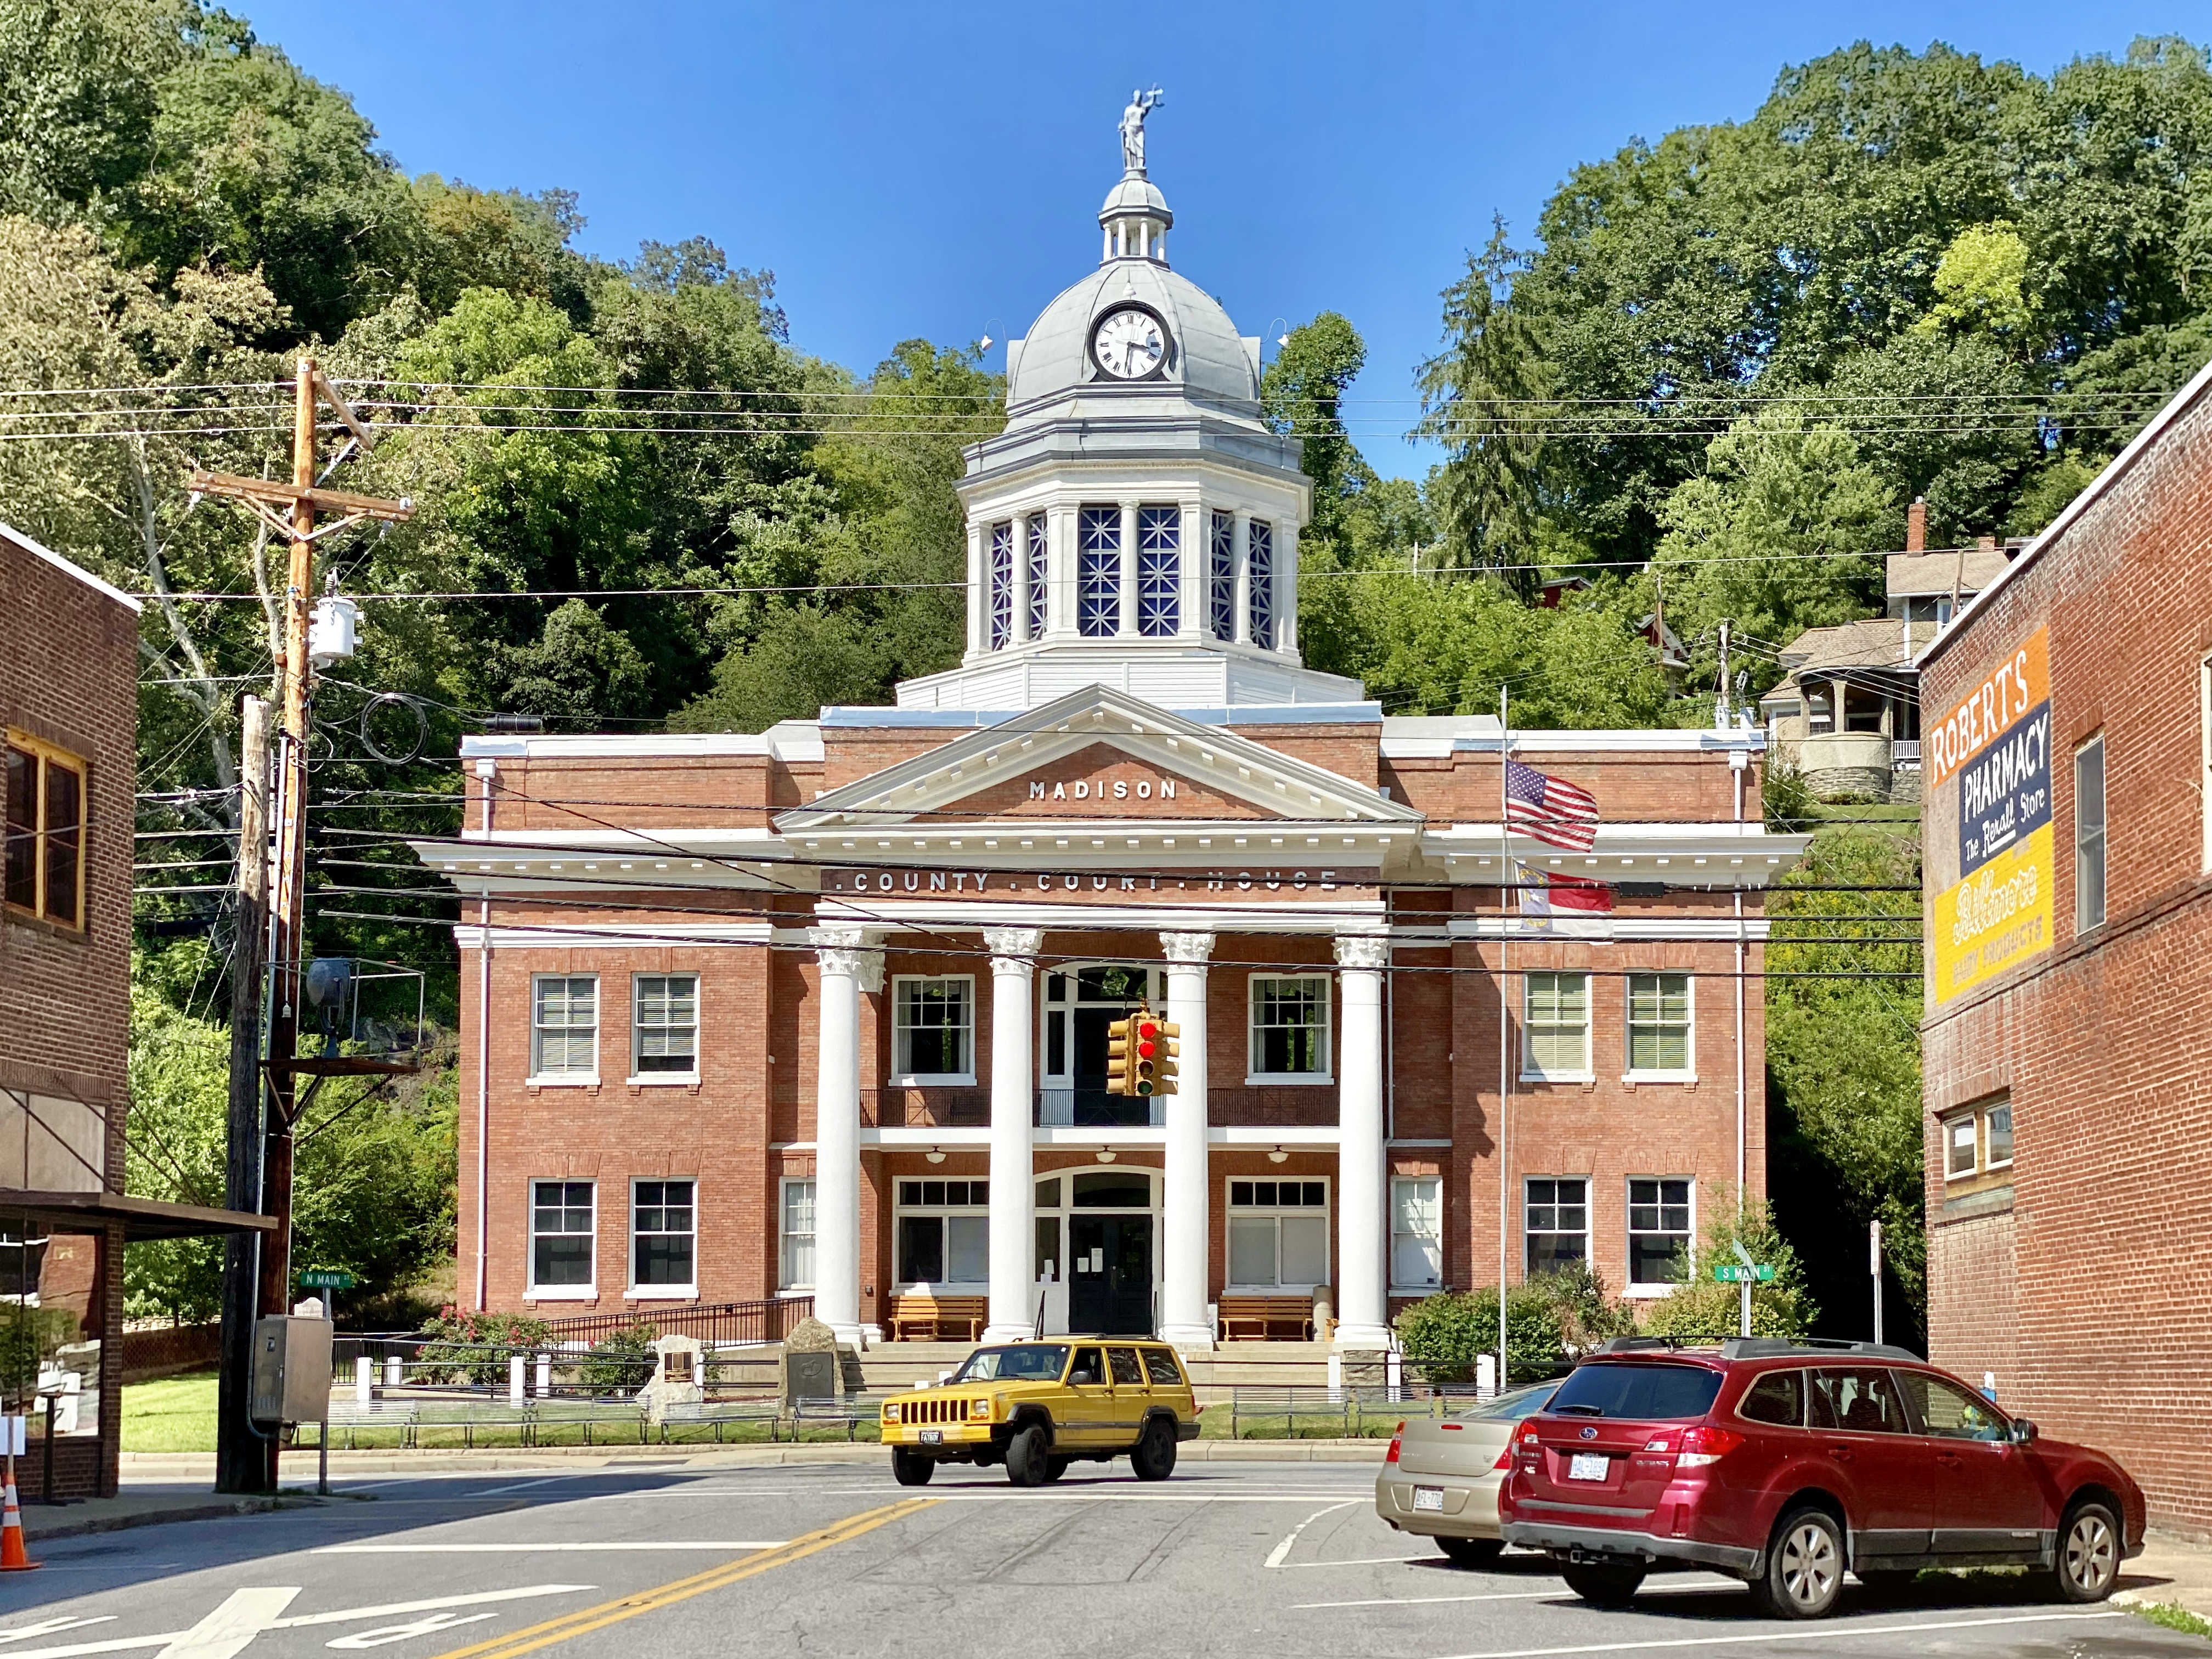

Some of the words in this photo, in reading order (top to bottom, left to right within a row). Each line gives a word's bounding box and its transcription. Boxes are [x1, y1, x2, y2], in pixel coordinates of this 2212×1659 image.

[1931, 650, 2028, 785] ROBERTS
[1965, 712, 2048, 823] PHARMACY
[1030, 781, 1175, 799] MADISON
[1966, 838, 1979, 861] The
[1982, 797, 2016, 858] Rexall
[2021, 788, 2045, 823] Store
[855, 872, 988, 890] COUNTY
[1207, 871, 1335, 889] HOUSE
[1982, 913, 2042, 968] PRODUCTS
[307, 1274, 313, 1284] N
[317, 1274, 340, 1285] MAIN
[1723, 1268, 1729, 1279] S
[1734, 1267, 1760, 1279] MAN
[1572, 1459, 1606, 1474] HAL-1894
